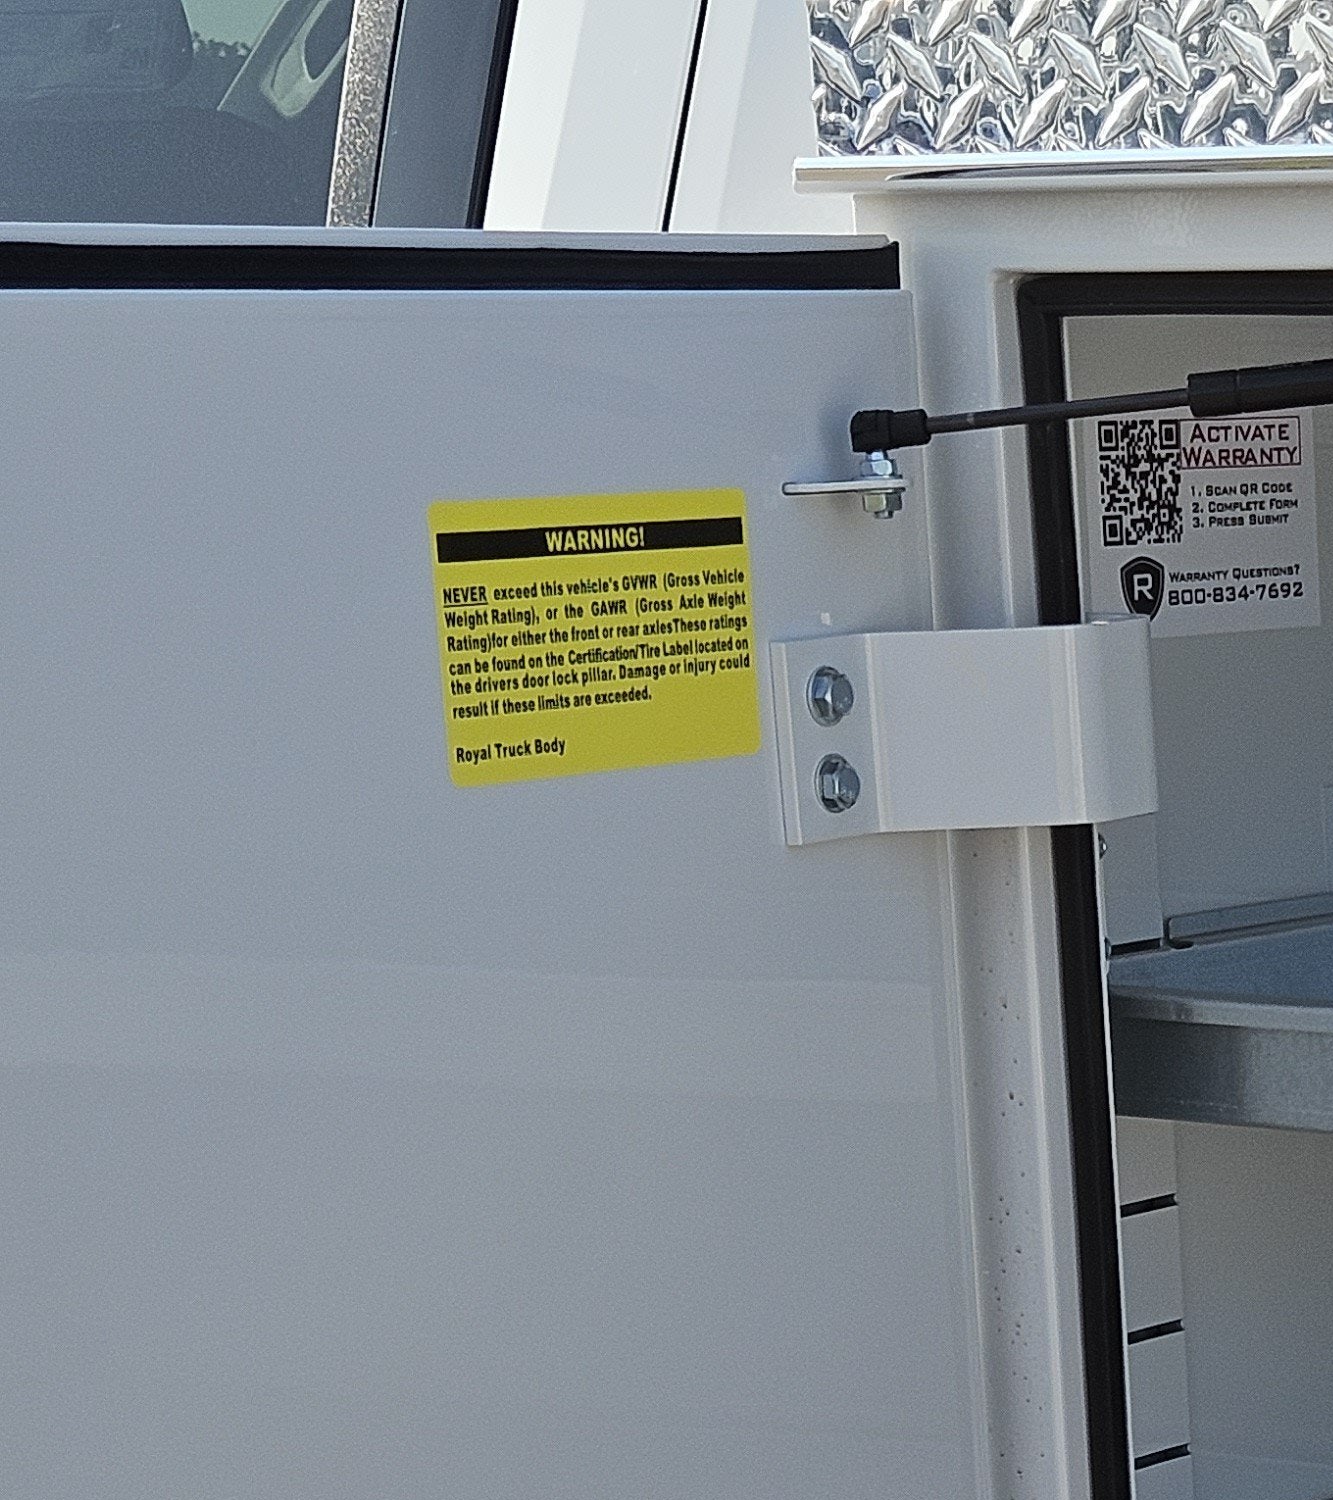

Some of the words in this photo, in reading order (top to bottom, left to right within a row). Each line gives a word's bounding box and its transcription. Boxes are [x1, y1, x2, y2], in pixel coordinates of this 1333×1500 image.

[1190, 423, 1290, 444] ACTIVATE
[1182, 446, 1298, 467] WARRANTY
[1191, 486, 1202, 497] 1.
[1205, 483, 1237, 497] SCAN
[1240, 483, 1258, 496] QR
[1262, 482, 1293, 494] CODE
[1192, 503, 1204, 514] 2.
[1208, 500, 1266, 513] COMPLETE
[1269, 498, 1299, 510] FORM
[1192, 516, 1205, 528] 3.
[1209, 514, 1244, 527] PRESS
[1249, 513, 1290, 526] SUBMIT
[545, 526, 645, 553] WARNING!
[443, 586, 487, 605] NEVER
[493, 583, 538, 600] exceed
[541, 581, 564, 597] this
[566, 577, 619, 595] vehicle's
[622, 574, 657, 591] GVWR
[663, 572, 700, 592] (Gross
[702, 568, 745, 585] Vehicle
[1133, 573, 1154, 600] R
[1169, 569, 1228, 583] WARRANTY
[1232, 564, 1301, 580] QUESTIONS?
[1168, 582, 1304, 606] 800-834-7692
[444, 610, 489, 630] Weight
[491, 606, 540, 626] Rating),
[546, 608, 558, 620] or
[564, 604, 584, 619] the
[591, 600, 627, 616] GAWR
[635, 597, 673, 617] (Gross
[679, 594, 704, 610] Axle
[707, 591, 746, 610] Weight
[511, 631, 547, 647] either
[549, 628, 568, 643] the
[571, 625, 600, 641] front
[602, 627, 614, 639] or
[616, 625, 640, 637] rear
[709, 614, 747, 632] ratings
[449, 662, 471, 676] can
[474, 658, 489, 673] be
[492, 654, 526, 672] found
[528, 656, 543, 668] on
[545, 651, 564, 666] the
[663, 639, 693, 657] Label
[694, 636, 733, 654] located
[735, 638, 749, 650] on
[450, 680, 472, 696] the
[475, 677, 519, 693] drivers
[522, 673, 550, 688] door
[552, 669, 579, 686] lock
[582, 667, 617, 687] pillar.
[619, 664, 666, 680] Damage
[669, 664, 681, 675] or
[683, 658, 717, 676] injury
[719, 653, 750, 670] could
[453, 701, 489, 719] result
[491, 700, 500, 715] if
[502, 698, 535, 714] these
[538, 694, 571, 711] limits
[573, 694, 592, 707] are
[595, 686, 652, 705] exceeded.
[456, 744, 492, 765] Royal
[494, 740, 532, 759] Truck
[535, 737, 566, 756] Body
